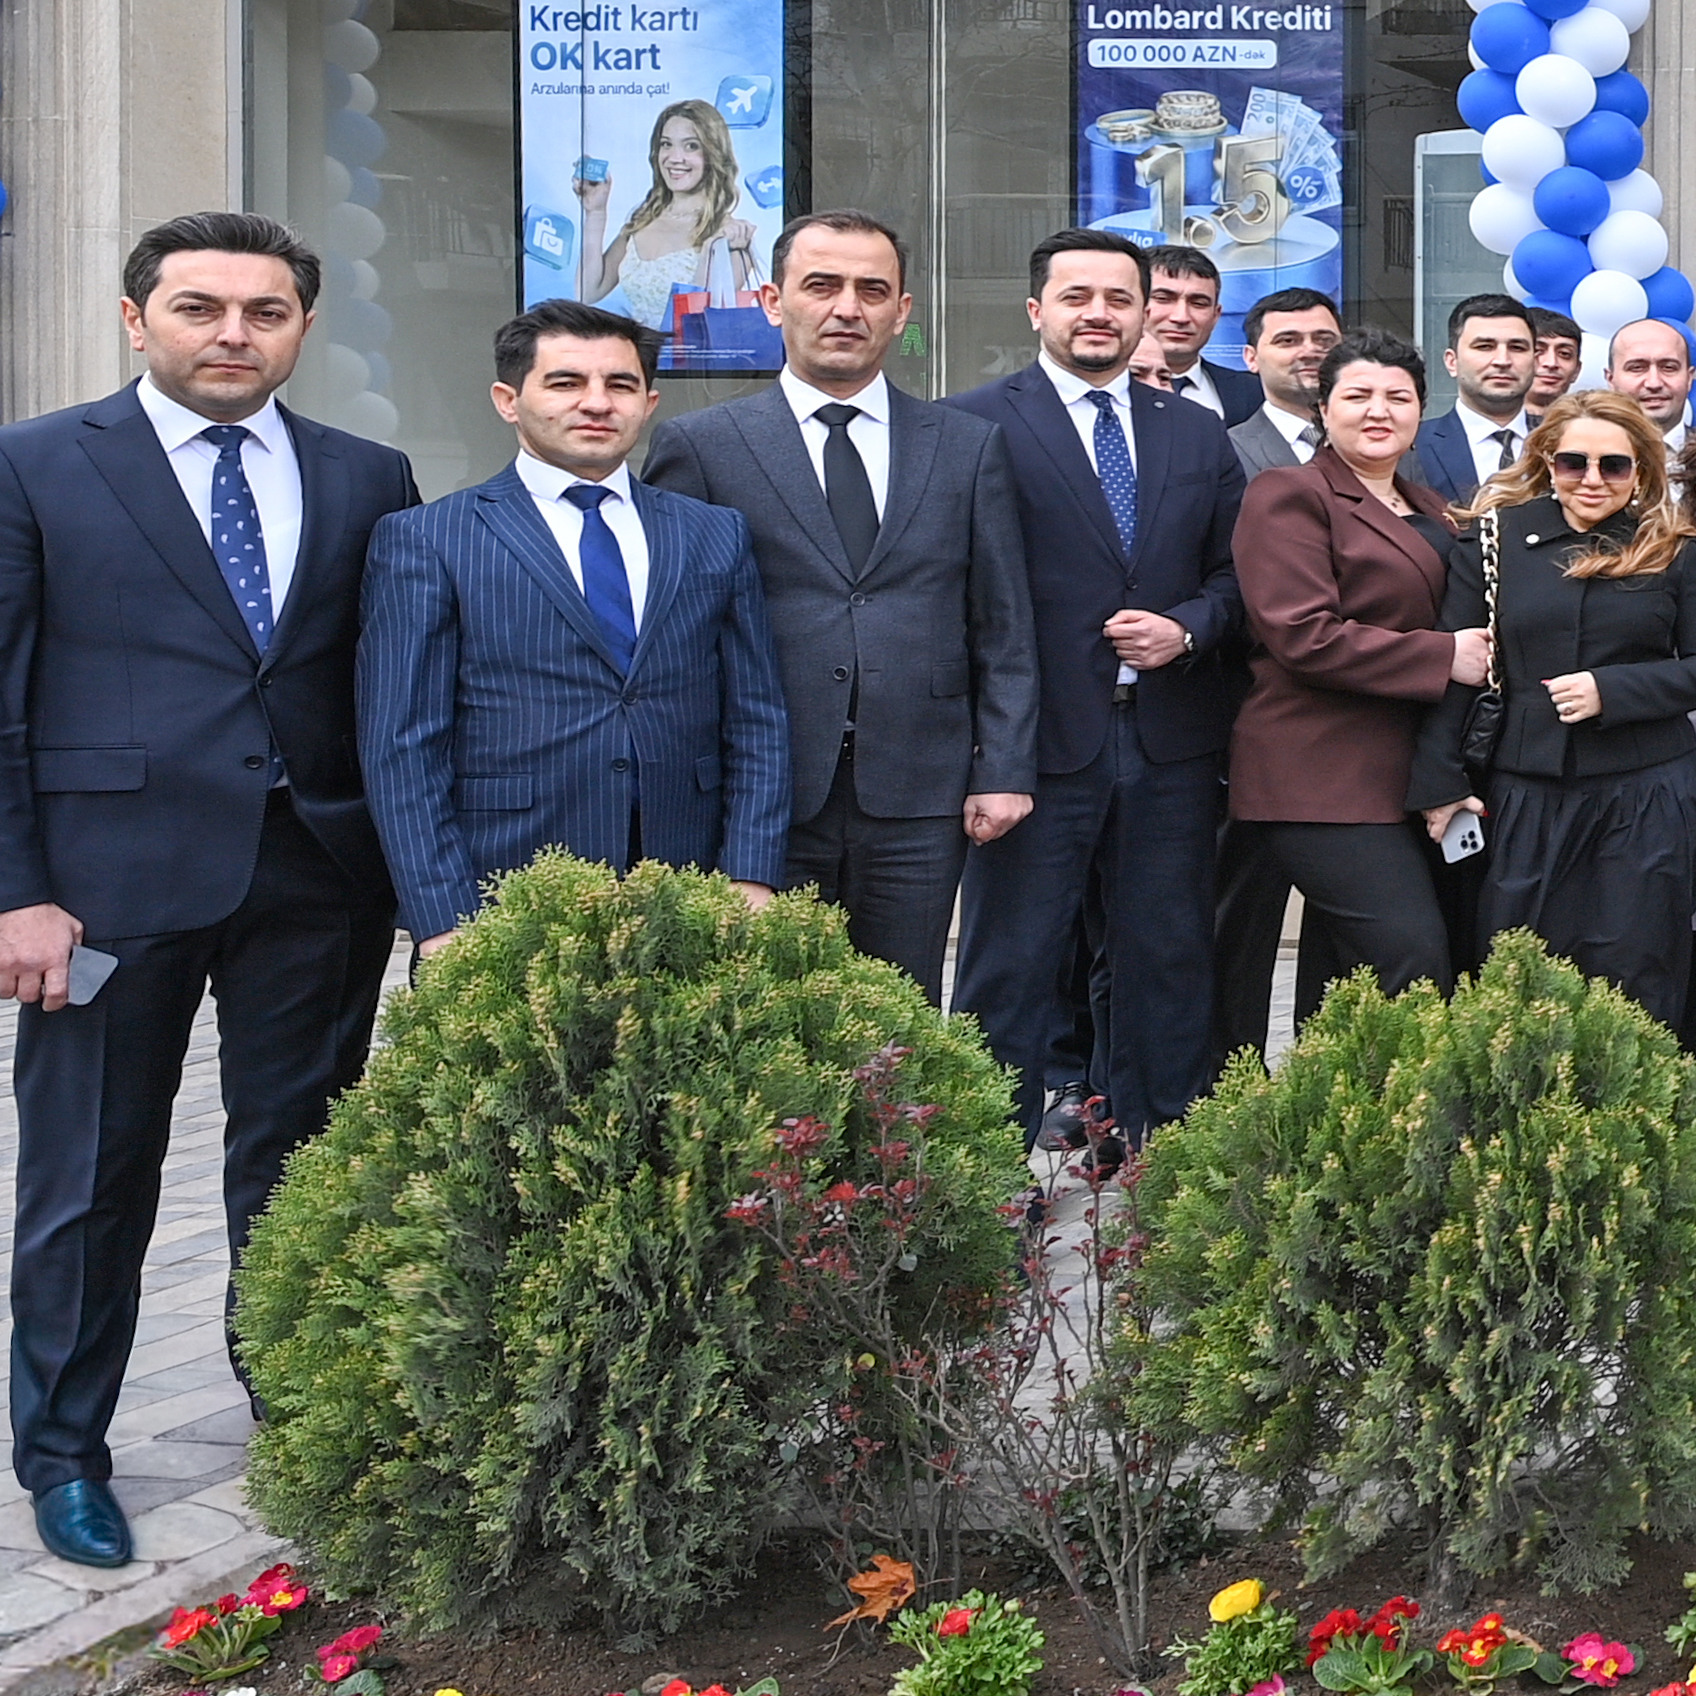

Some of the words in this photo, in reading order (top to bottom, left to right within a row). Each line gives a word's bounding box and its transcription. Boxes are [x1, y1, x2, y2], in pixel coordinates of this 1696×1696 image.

[530, 4, 622, 32] Kredit
[631, 4, 699, 32] kartı
[1087, 4, 1223, 30] Lombard
[1231, 4, 1332, 31] Krediti
[530, 41, 582, 71] OK
[593, 41, 661, 71] kart
[1096, 45, 1137, 62] 100
[1143, 45, 1186, 62] 000
